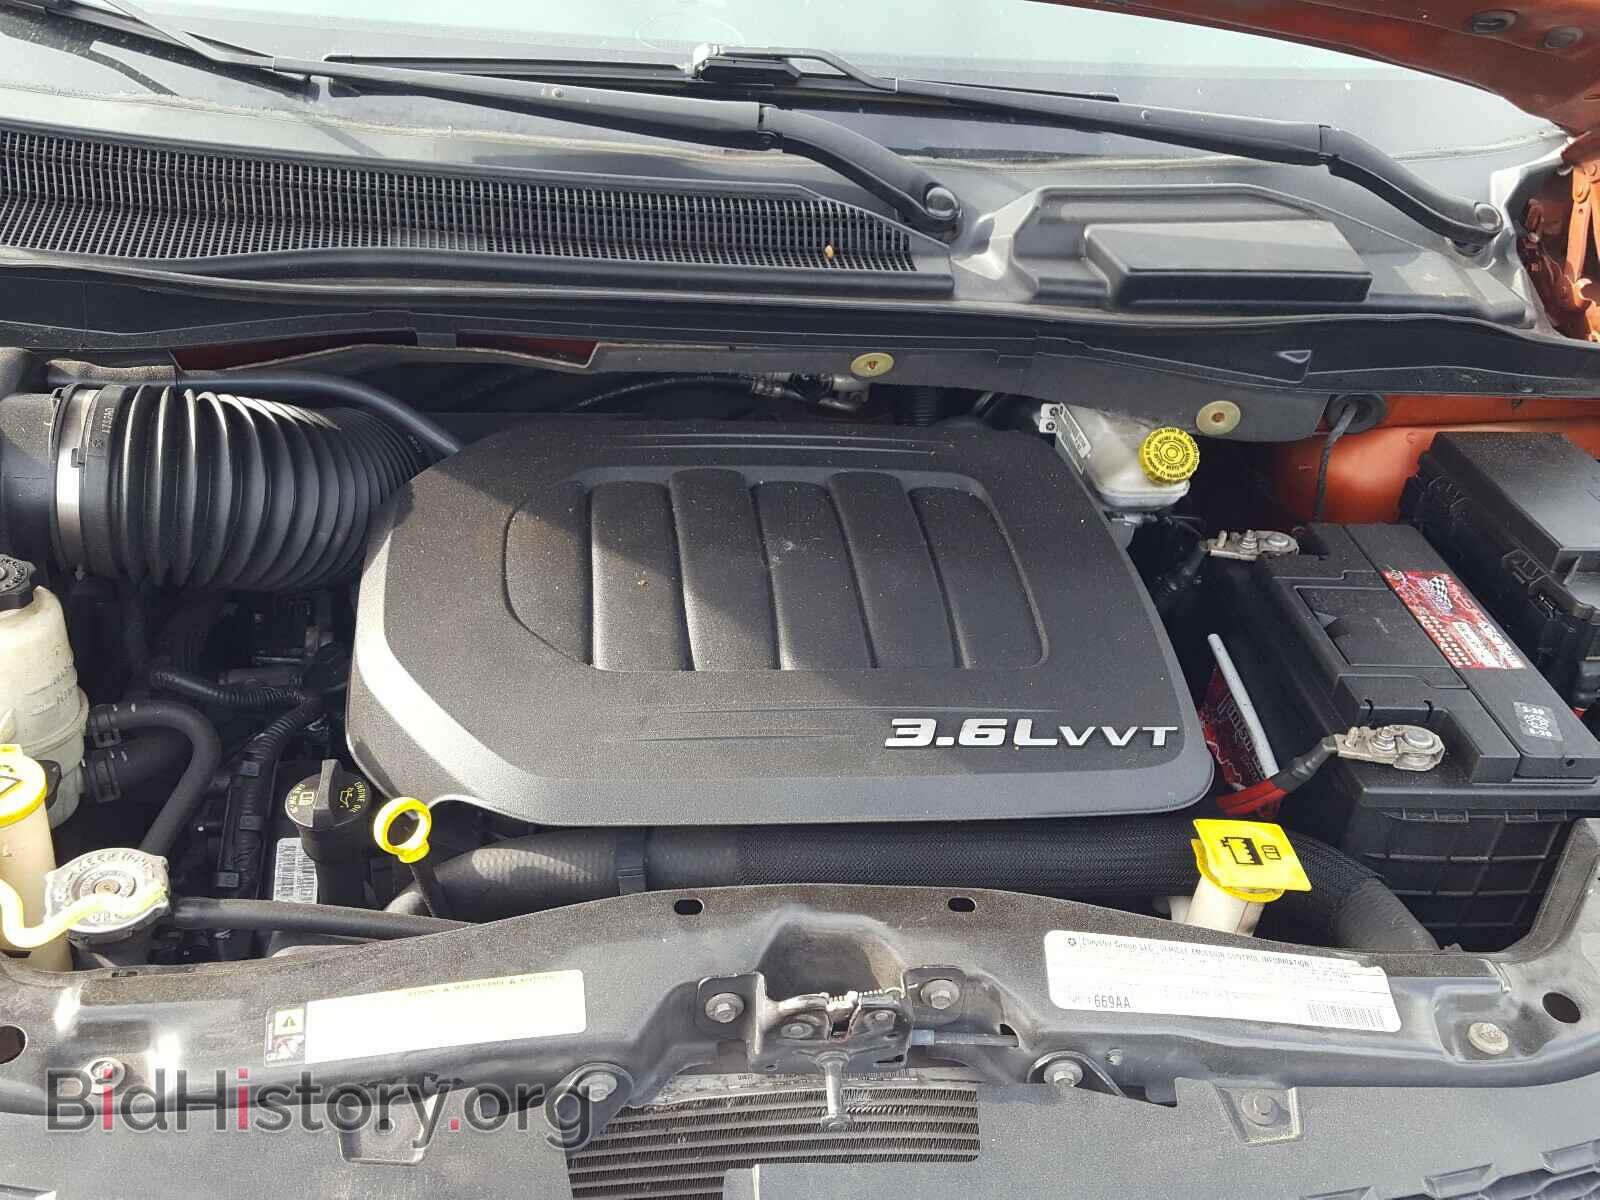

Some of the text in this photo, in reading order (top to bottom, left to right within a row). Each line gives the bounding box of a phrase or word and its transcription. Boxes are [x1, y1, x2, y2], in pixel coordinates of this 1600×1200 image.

[884, 718, 1179, 748] 3.6L VVT
[354, 781, 367, 803] ENGINE
